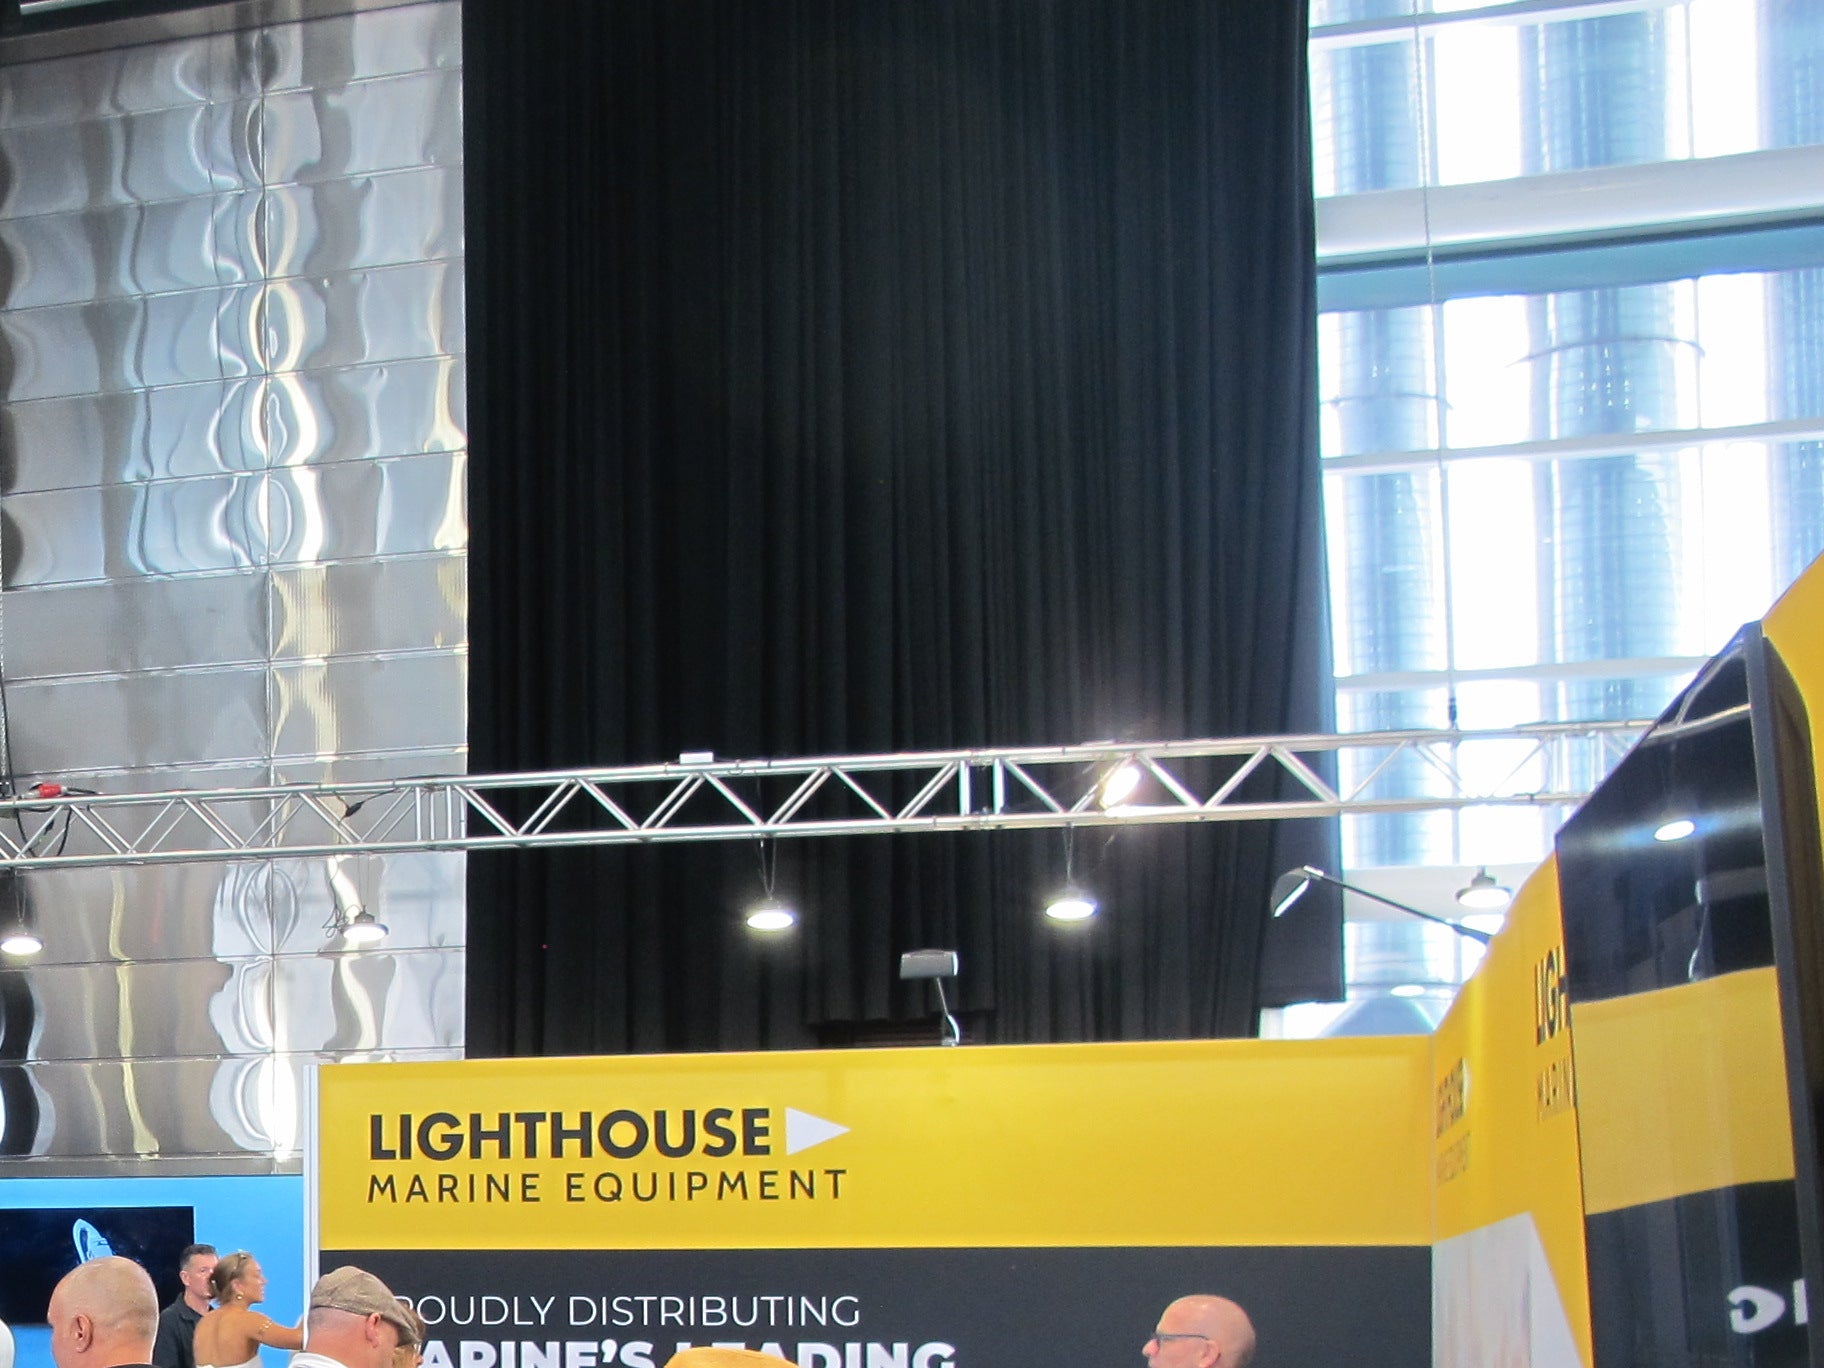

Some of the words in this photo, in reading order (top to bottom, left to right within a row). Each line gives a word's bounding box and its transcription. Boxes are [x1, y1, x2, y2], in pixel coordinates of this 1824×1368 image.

[369, 1108, 771, 1161] LIGHTHOUSE
[367, 1172, 541, 1203] MARINE
[565, 1169, 846, 1202] EQUIPMENT
[394, 1295, 556, 1327] OUDLY
[569, 1295, 860, 1327] DISTRIBUTING
